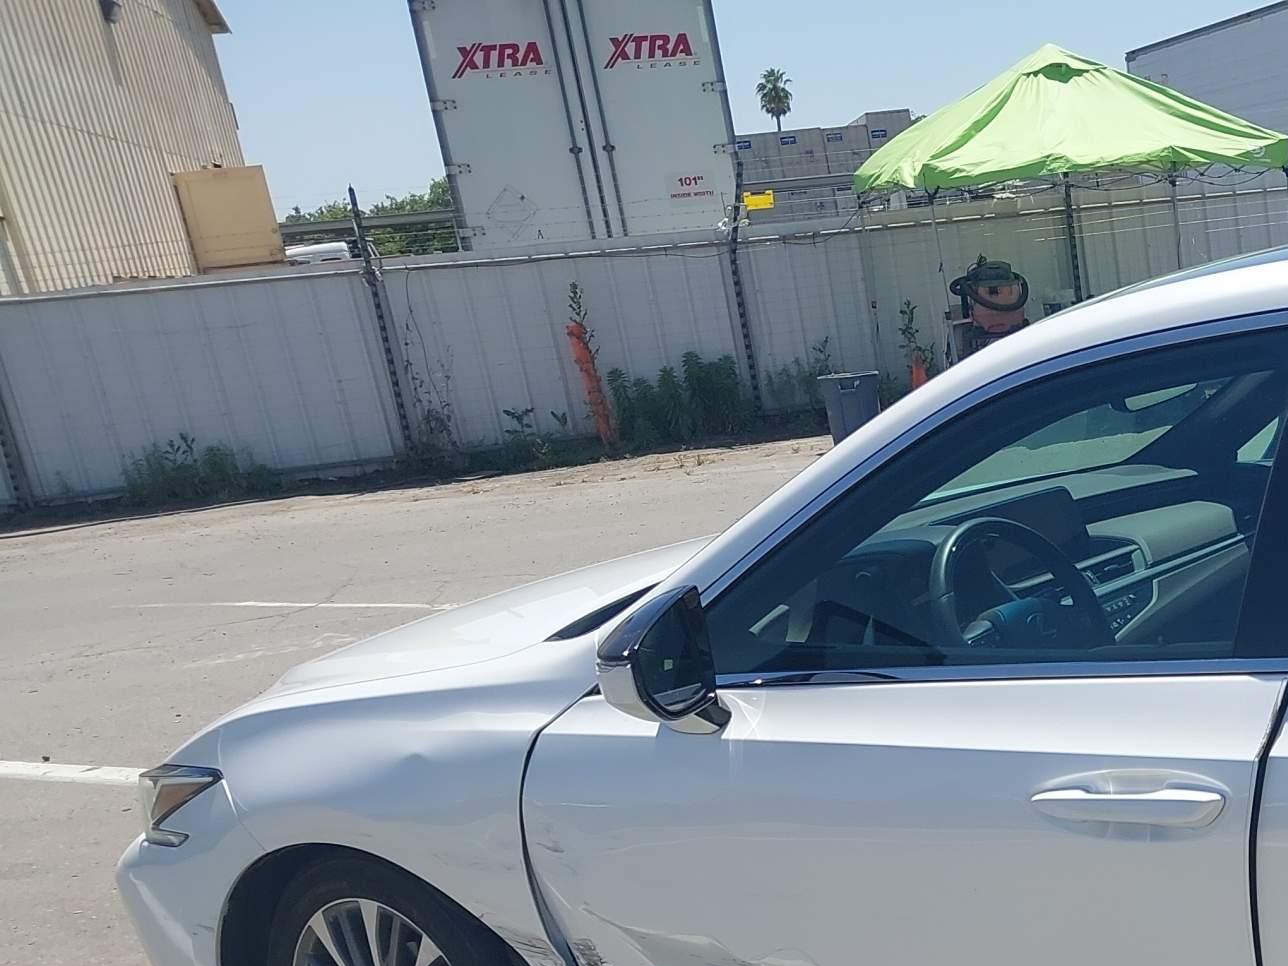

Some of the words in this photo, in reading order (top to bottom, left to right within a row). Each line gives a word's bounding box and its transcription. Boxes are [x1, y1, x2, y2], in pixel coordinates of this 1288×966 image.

[603, 32, 693, 69] XTRA
[451, 42, 544, 79] XTRA
[637, 60, 700, 69] LEASE
[486, 69, 552, 79] LEASE
[678, 175, 703, 187] 101"
